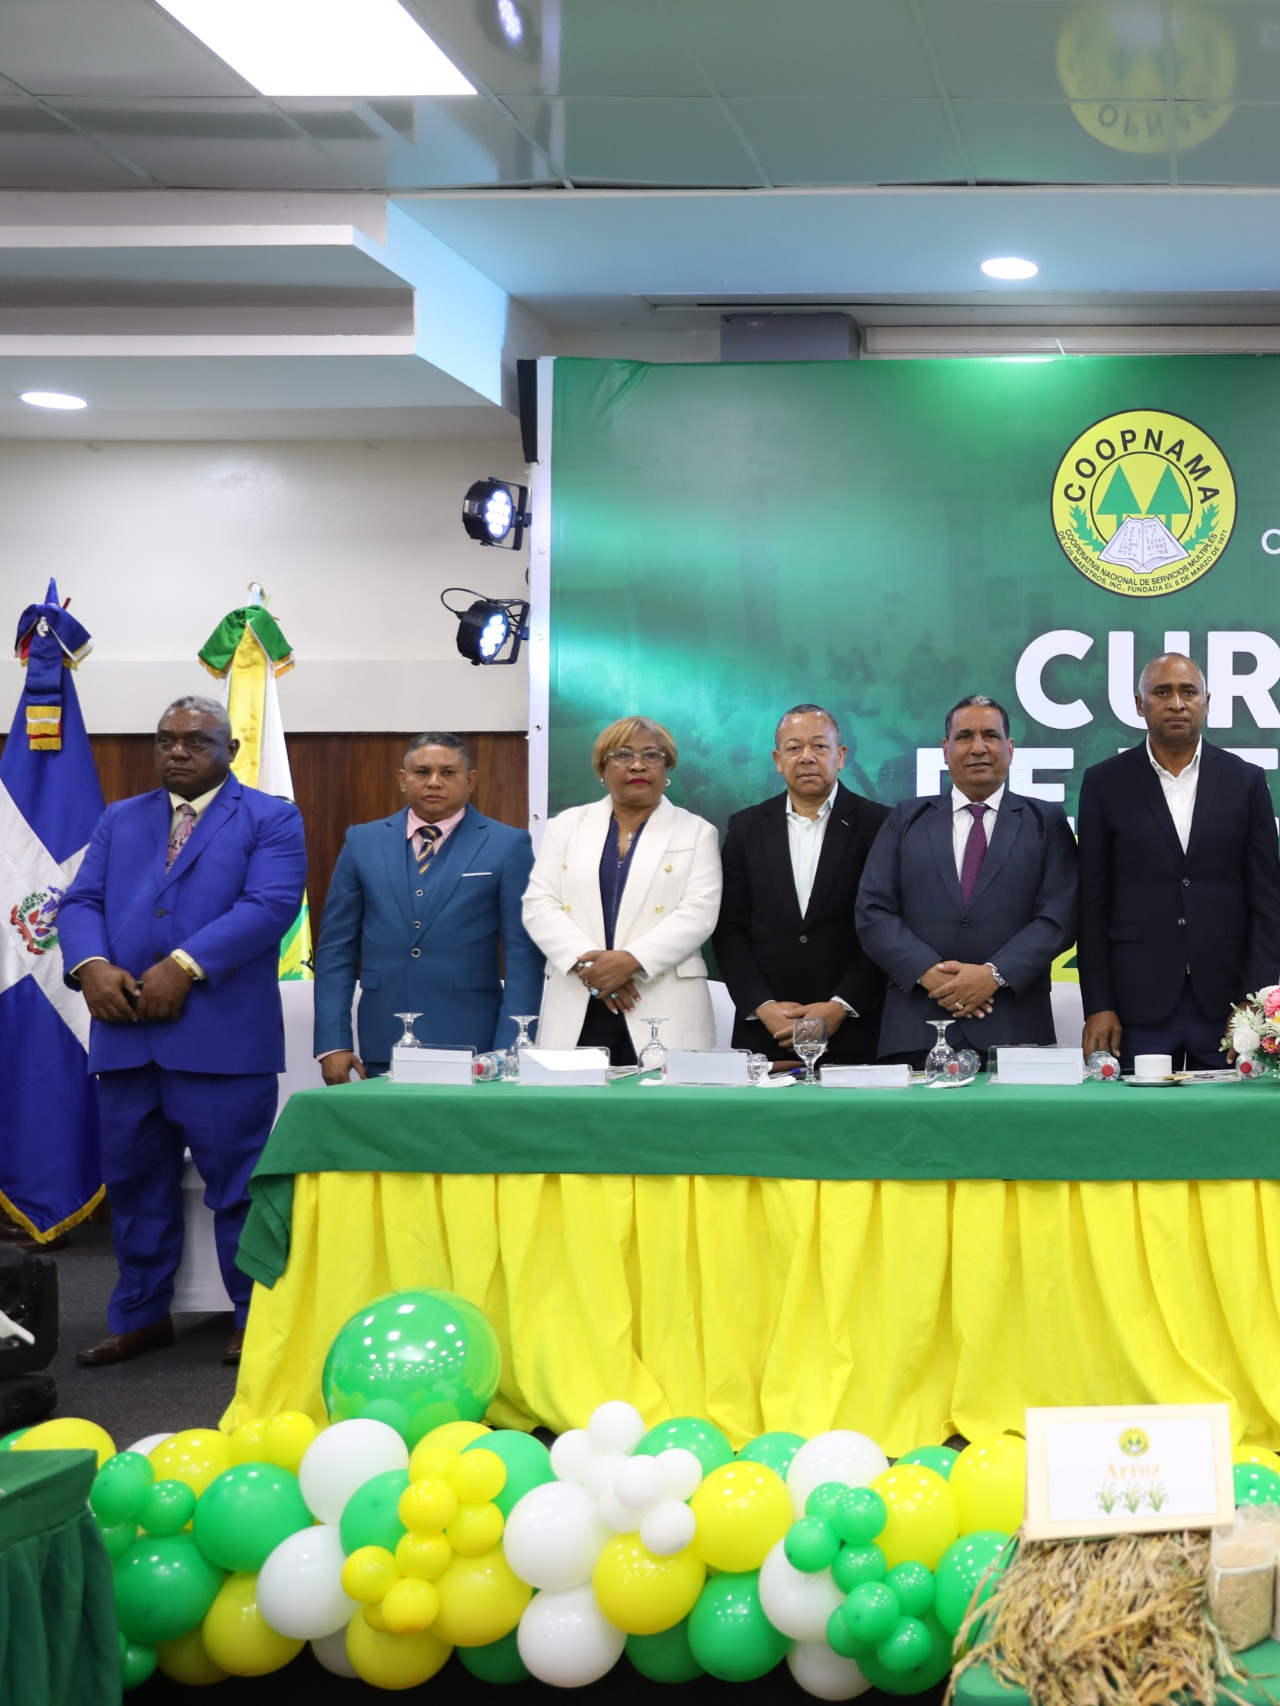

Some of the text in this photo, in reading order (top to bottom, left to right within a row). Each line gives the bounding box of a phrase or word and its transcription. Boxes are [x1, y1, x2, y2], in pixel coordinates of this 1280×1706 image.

[1063, 428, 1220, 505] COOPNAMA
[1058, 530, 1067, 542] DE
[1217, 529, 1228, 545] 1971
[1062, 541, 1075, 557] LOS
[1211, 545, 1221, 556] DE
[1065, 529, 1101, 573] COOPERATIVA
[1100, 568, 1138, 586] NACIONAL
[1139, 578, 1150, 587] DE
[1151, 564, 1190, 586] SERVICIOS
[1190, 556, 1213, 577] MARZO
[1164, 582, 1174, 590] EL
[1180, 574, 1191, 583] DE
[1127, 584, 1164, 593] FUNDADA
[1103, 1461, 1161, 1478] Arroz
